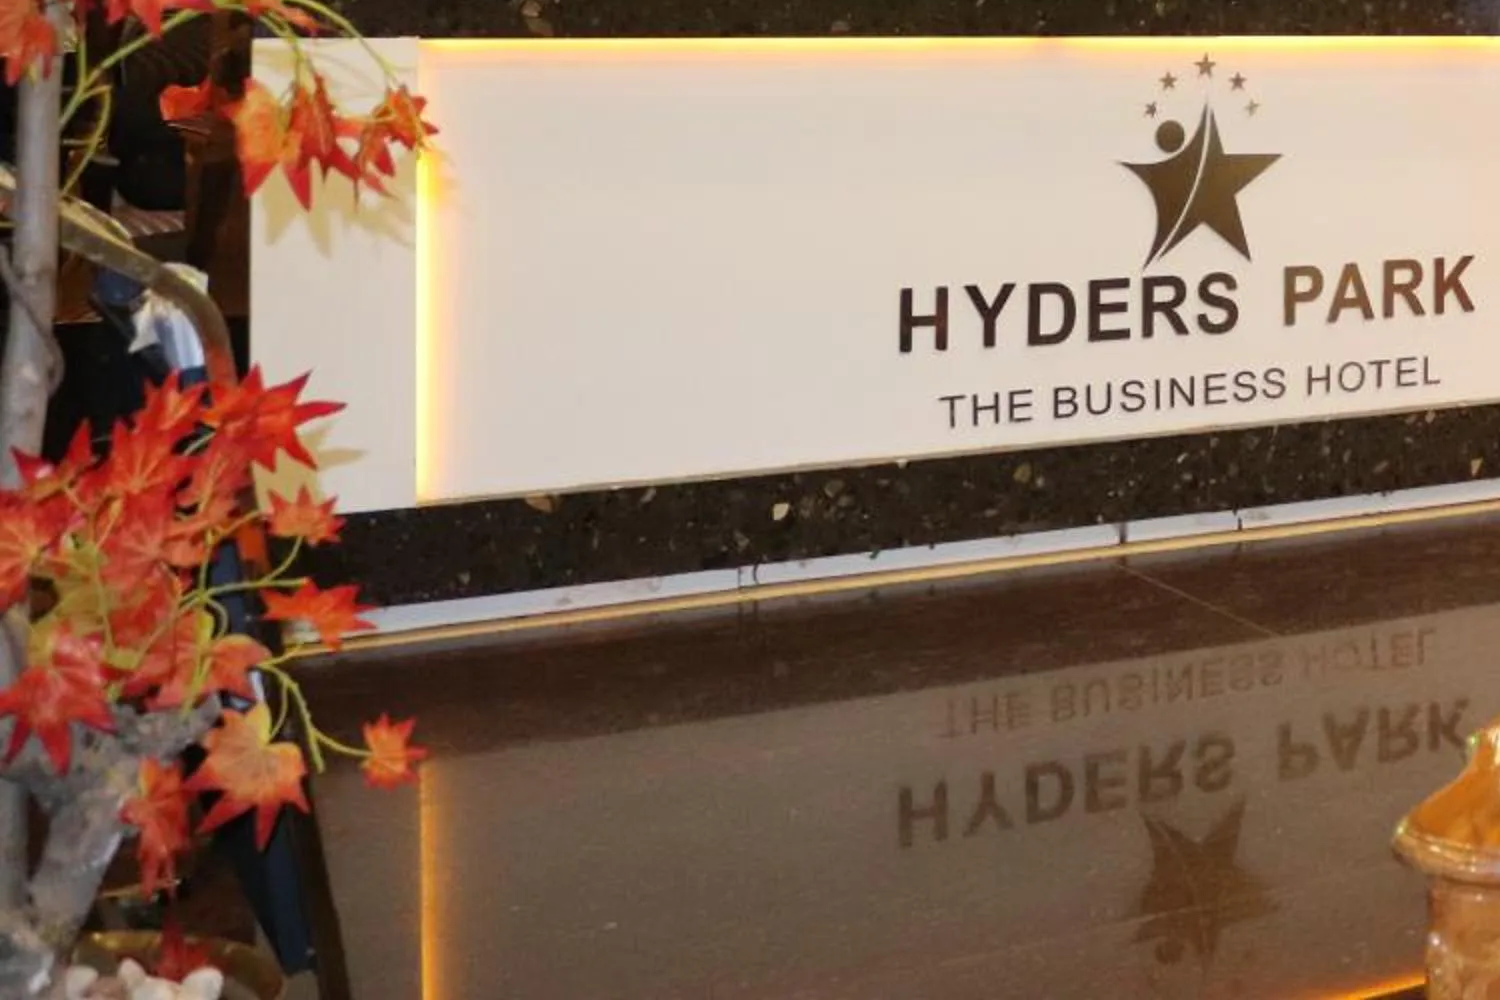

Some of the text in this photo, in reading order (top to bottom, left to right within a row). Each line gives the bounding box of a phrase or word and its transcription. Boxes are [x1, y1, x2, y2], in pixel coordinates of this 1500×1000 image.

[899, 256, 1475, 353] HYDERS PARK
[938, 356, 1441, 428] THE BUSINESS HOTEL
